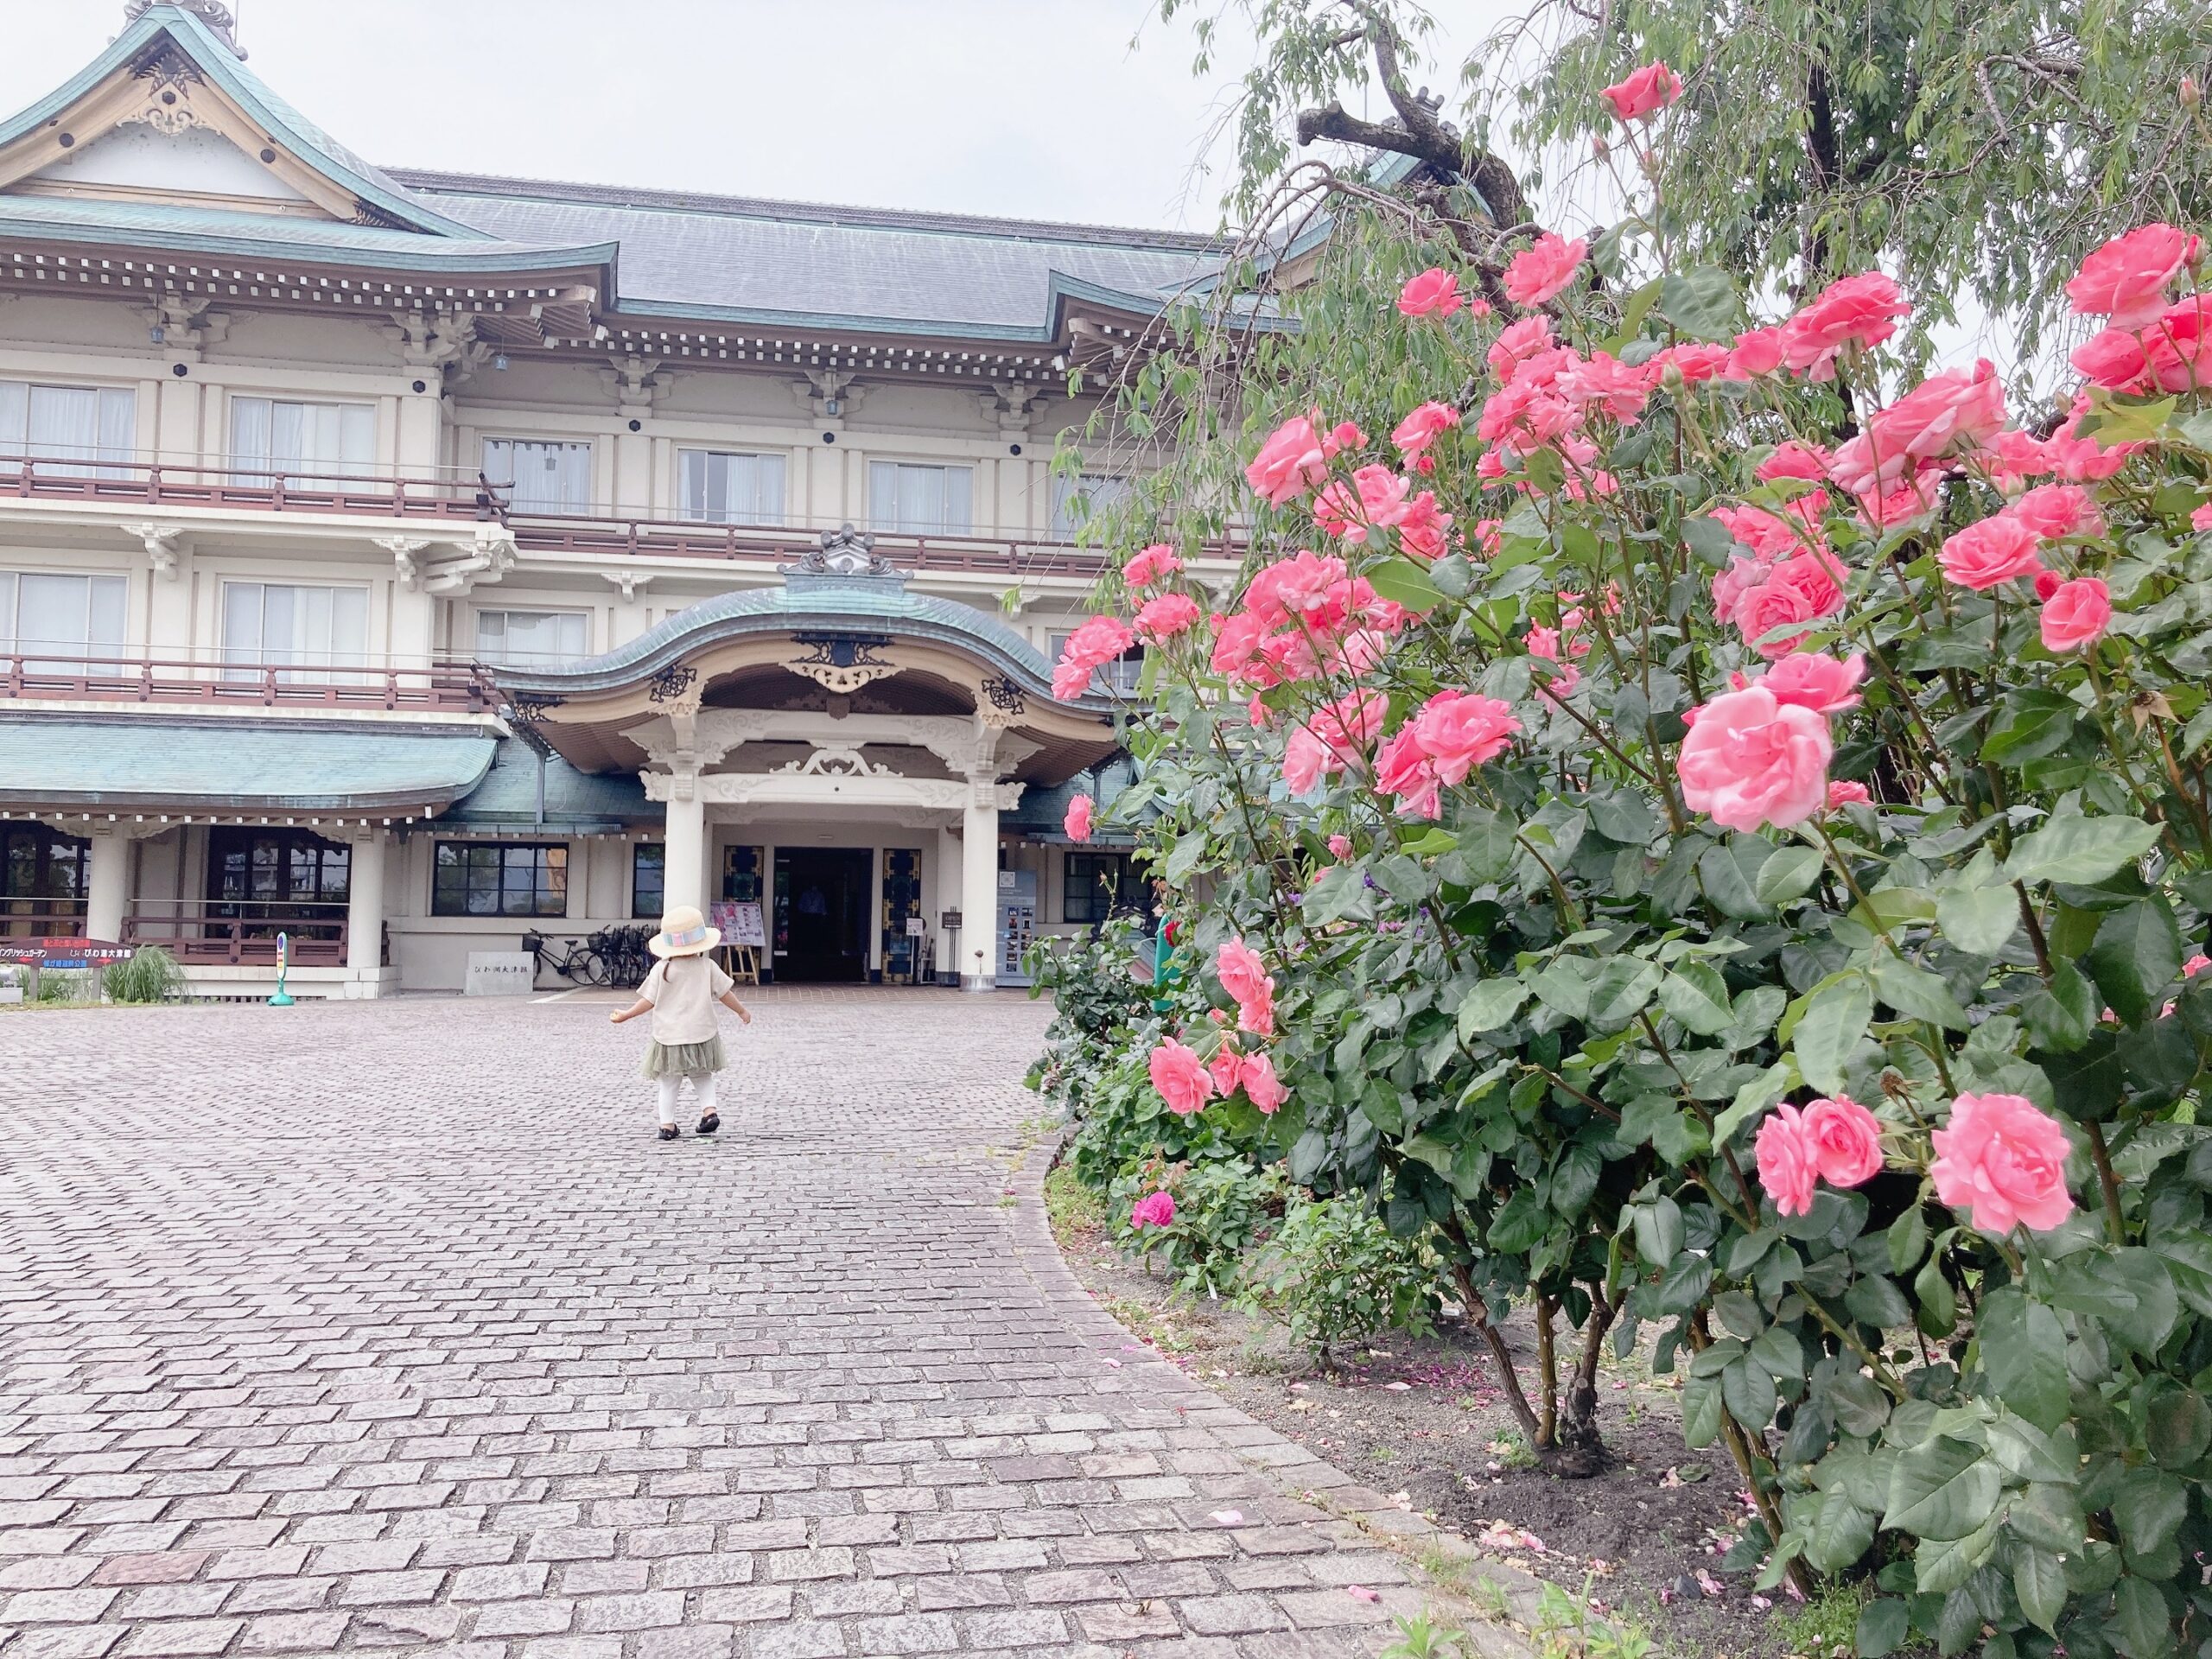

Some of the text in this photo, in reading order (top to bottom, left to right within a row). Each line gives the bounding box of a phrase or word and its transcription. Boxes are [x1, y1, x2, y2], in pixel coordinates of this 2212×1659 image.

[84, 949, 131, 958] びわ湖大津館
